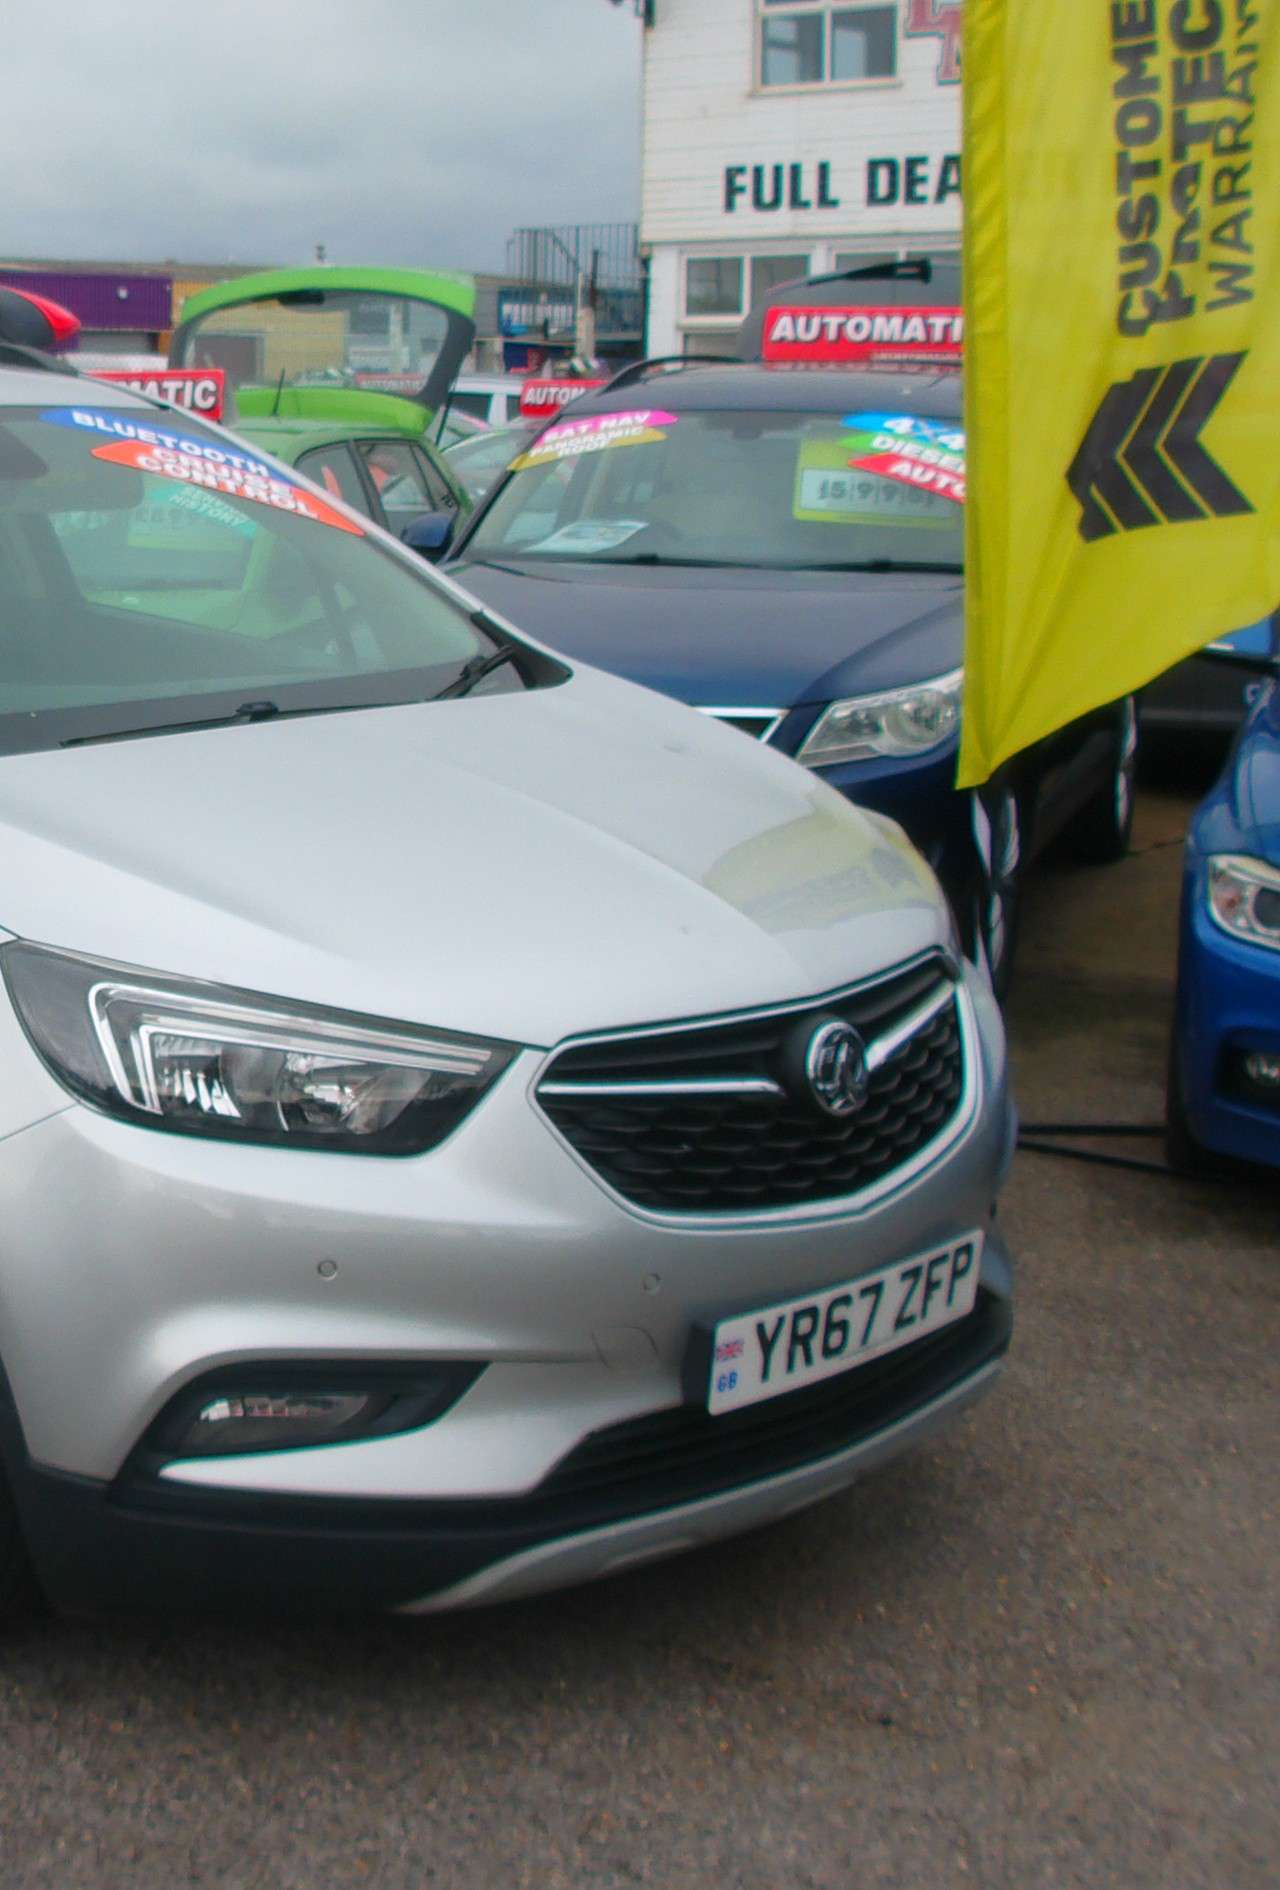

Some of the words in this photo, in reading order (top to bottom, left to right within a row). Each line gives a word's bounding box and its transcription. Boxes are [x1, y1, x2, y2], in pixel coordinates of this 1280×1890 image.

[723, 159, 840, 213] FULL
[866, 153, 963, 207] DEA
[71, 410, 269, 477] BLUETOOTH
[542, 423, 592, 442] SAT
[599, 410, 652, 431] NAV
[135, 454, 319, 519] CONTROL
[152, 446, 293, 498] CRUISE
[755, 1279, 886, 1383] YR67
[894, 1241, 974, 1332] ZFP
[716, 1371, 738, 1393] GB
